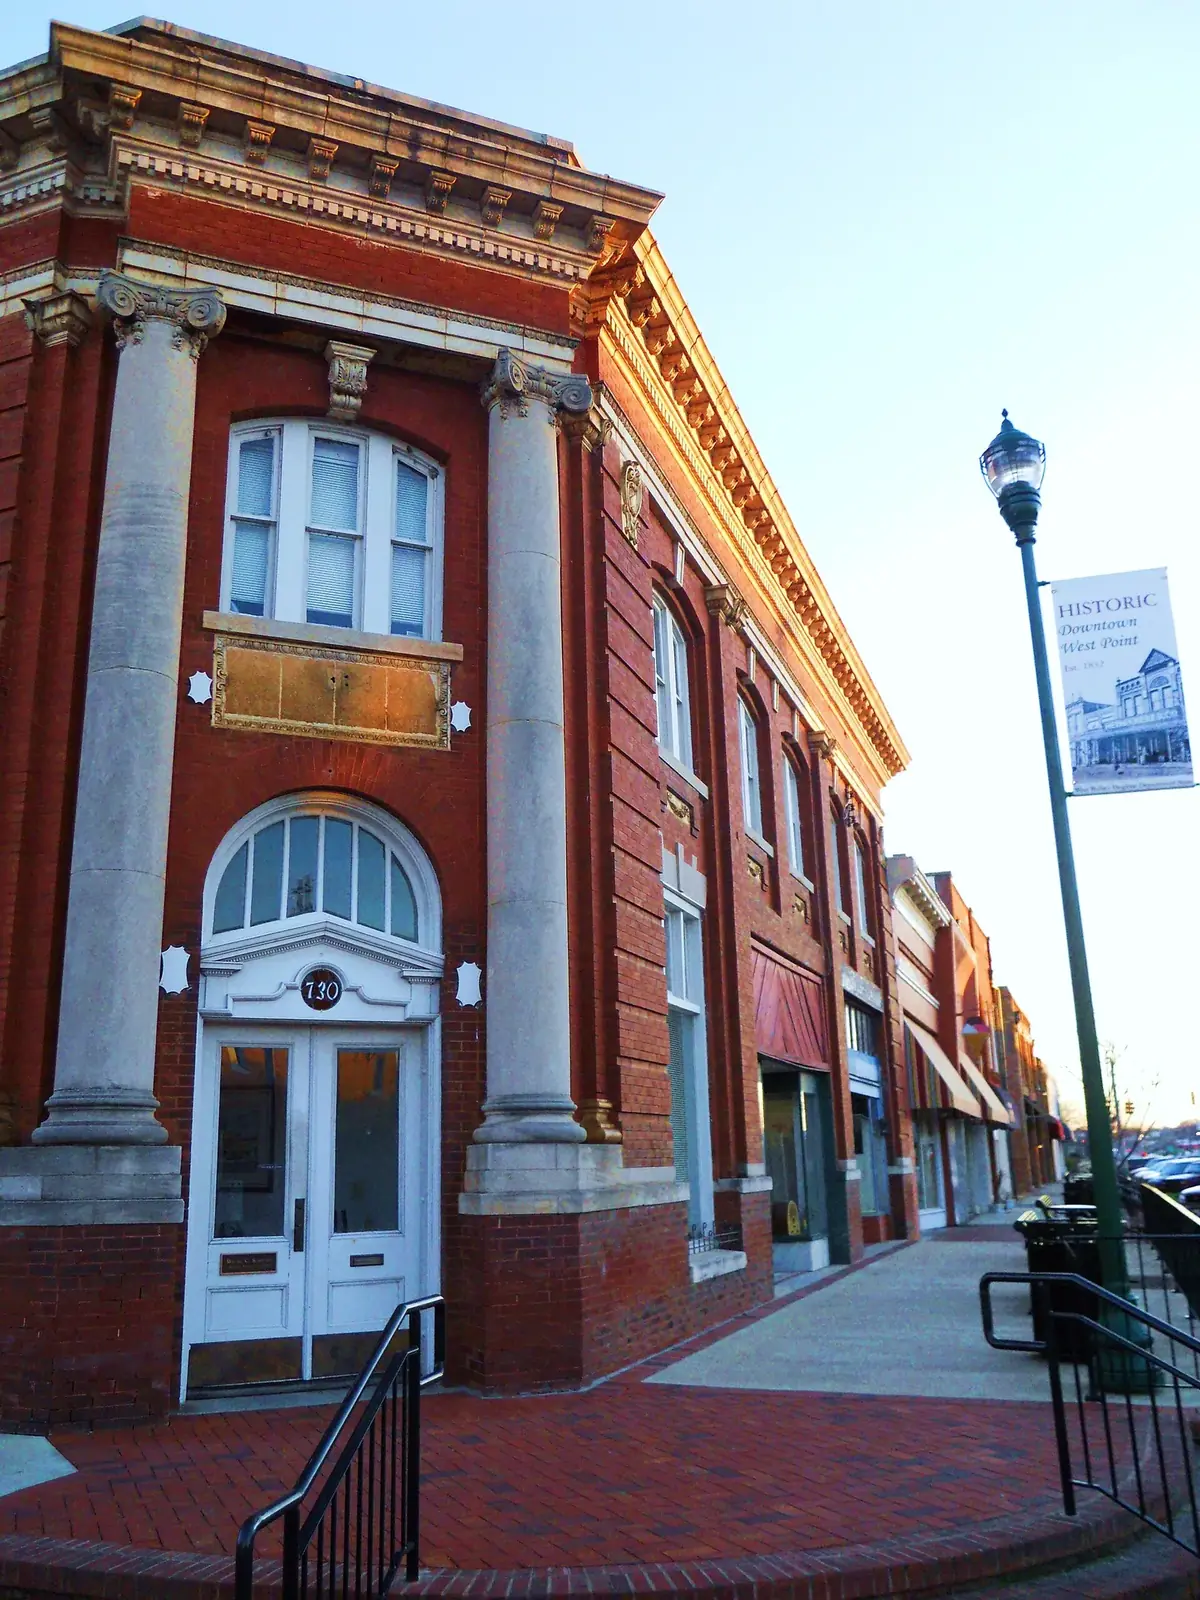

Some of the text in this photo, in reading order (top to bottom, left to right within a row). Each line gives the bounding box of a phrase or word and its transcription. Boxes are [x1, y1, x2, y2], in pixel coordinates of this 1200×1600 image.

[1058, 593, 1157, 618] HISTORIC
[1058, 618, 1137, 636] Downtown
[1060, 635, 1138, 654] West Point
[305, 981, 339, 1001] 730
